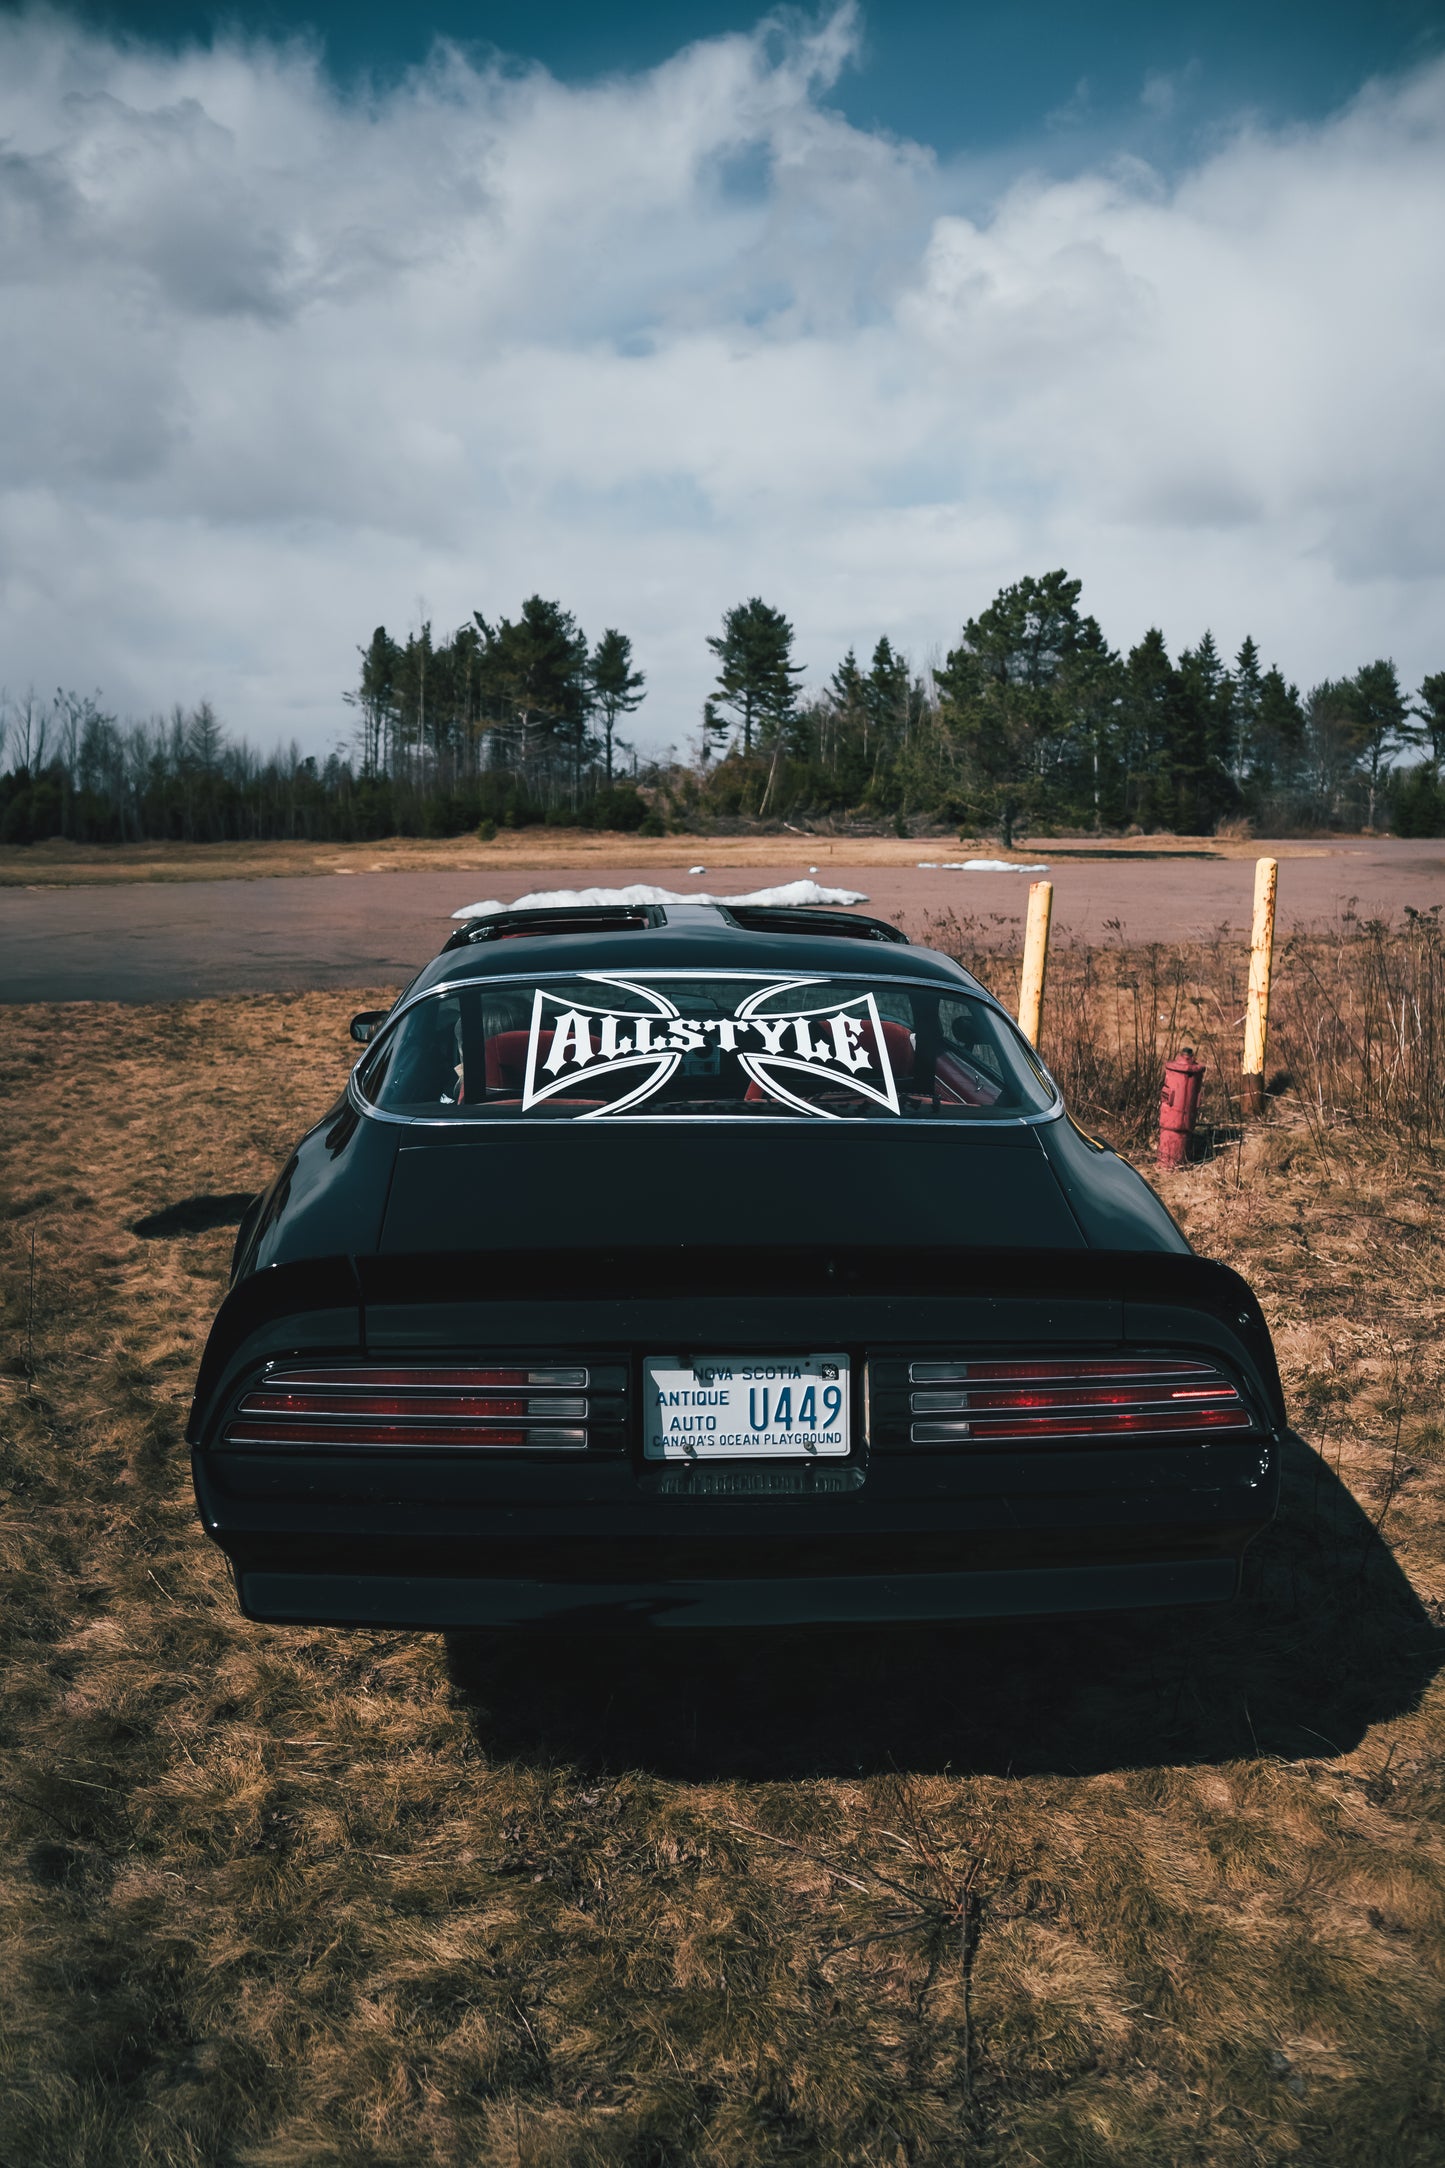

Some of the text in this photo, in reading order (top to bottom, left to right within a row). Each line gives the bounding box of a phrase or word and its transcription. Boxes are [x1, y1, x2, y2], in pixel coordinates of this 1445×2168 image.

[542, 1009, 873, 1076] ALLSTYLE
[692, 1366, 802, 1381] NOVA SCOTIA
[656, 1390, 730, 1407] ANTIQUE
[749, 1385, 842, 1432] U449
[669, 1415, 717, 1432] AUTO
[652, 1432, 842, 1447] CANADA'S OCEAN PLAYGROUND
